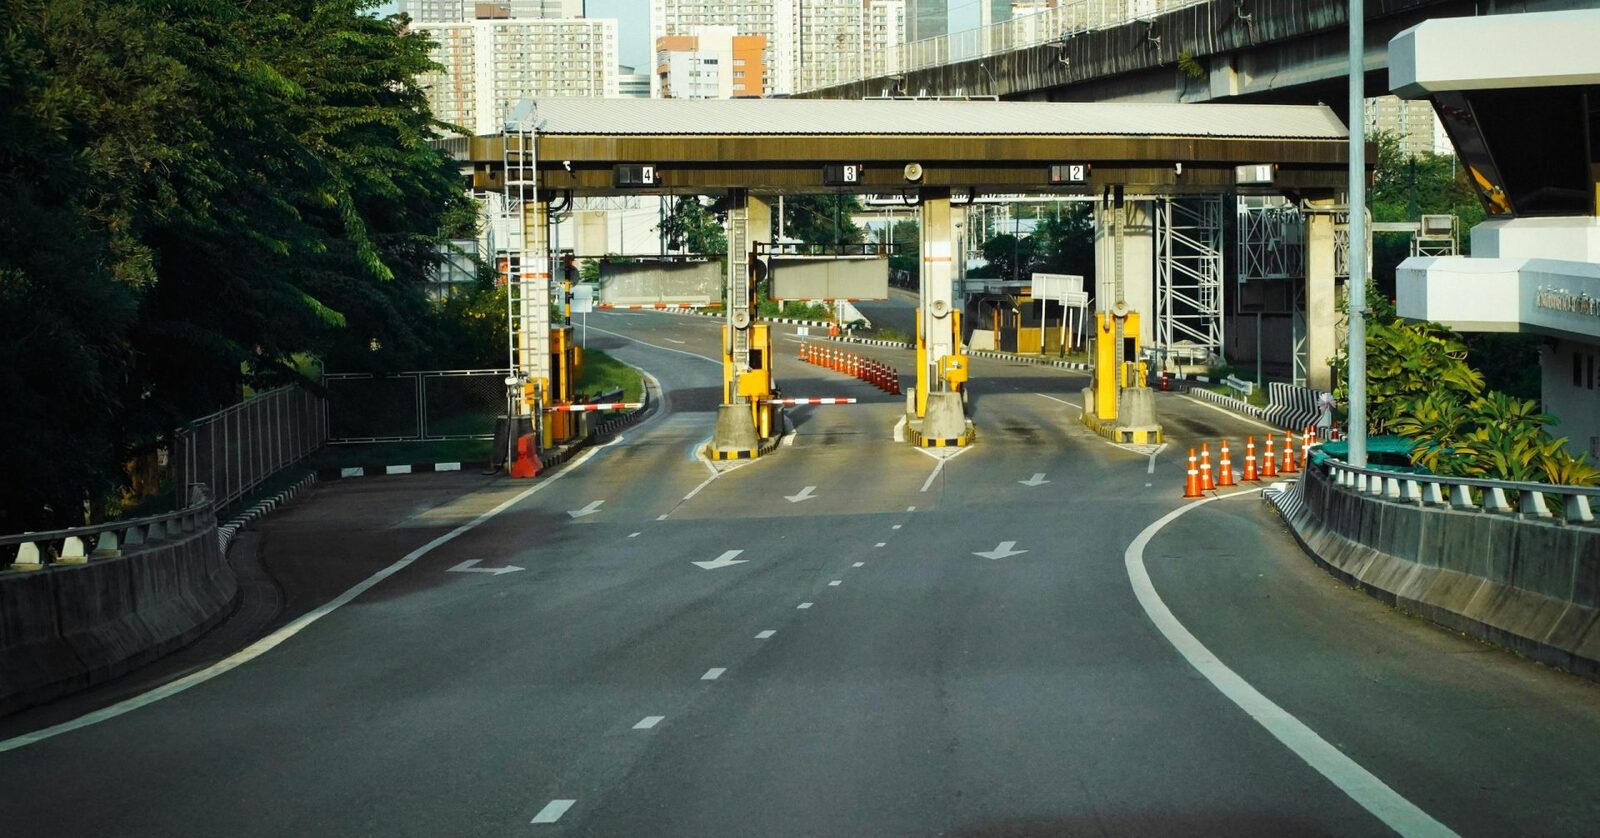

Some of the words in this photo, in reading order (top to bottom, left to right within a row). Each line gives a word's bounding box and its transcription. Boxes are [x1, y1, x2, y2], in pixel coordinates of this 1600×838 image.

[644, 169, 651, 181] 4
[847, 166, 854, 181] 3
[1073, 166, 1080, 180] 2
